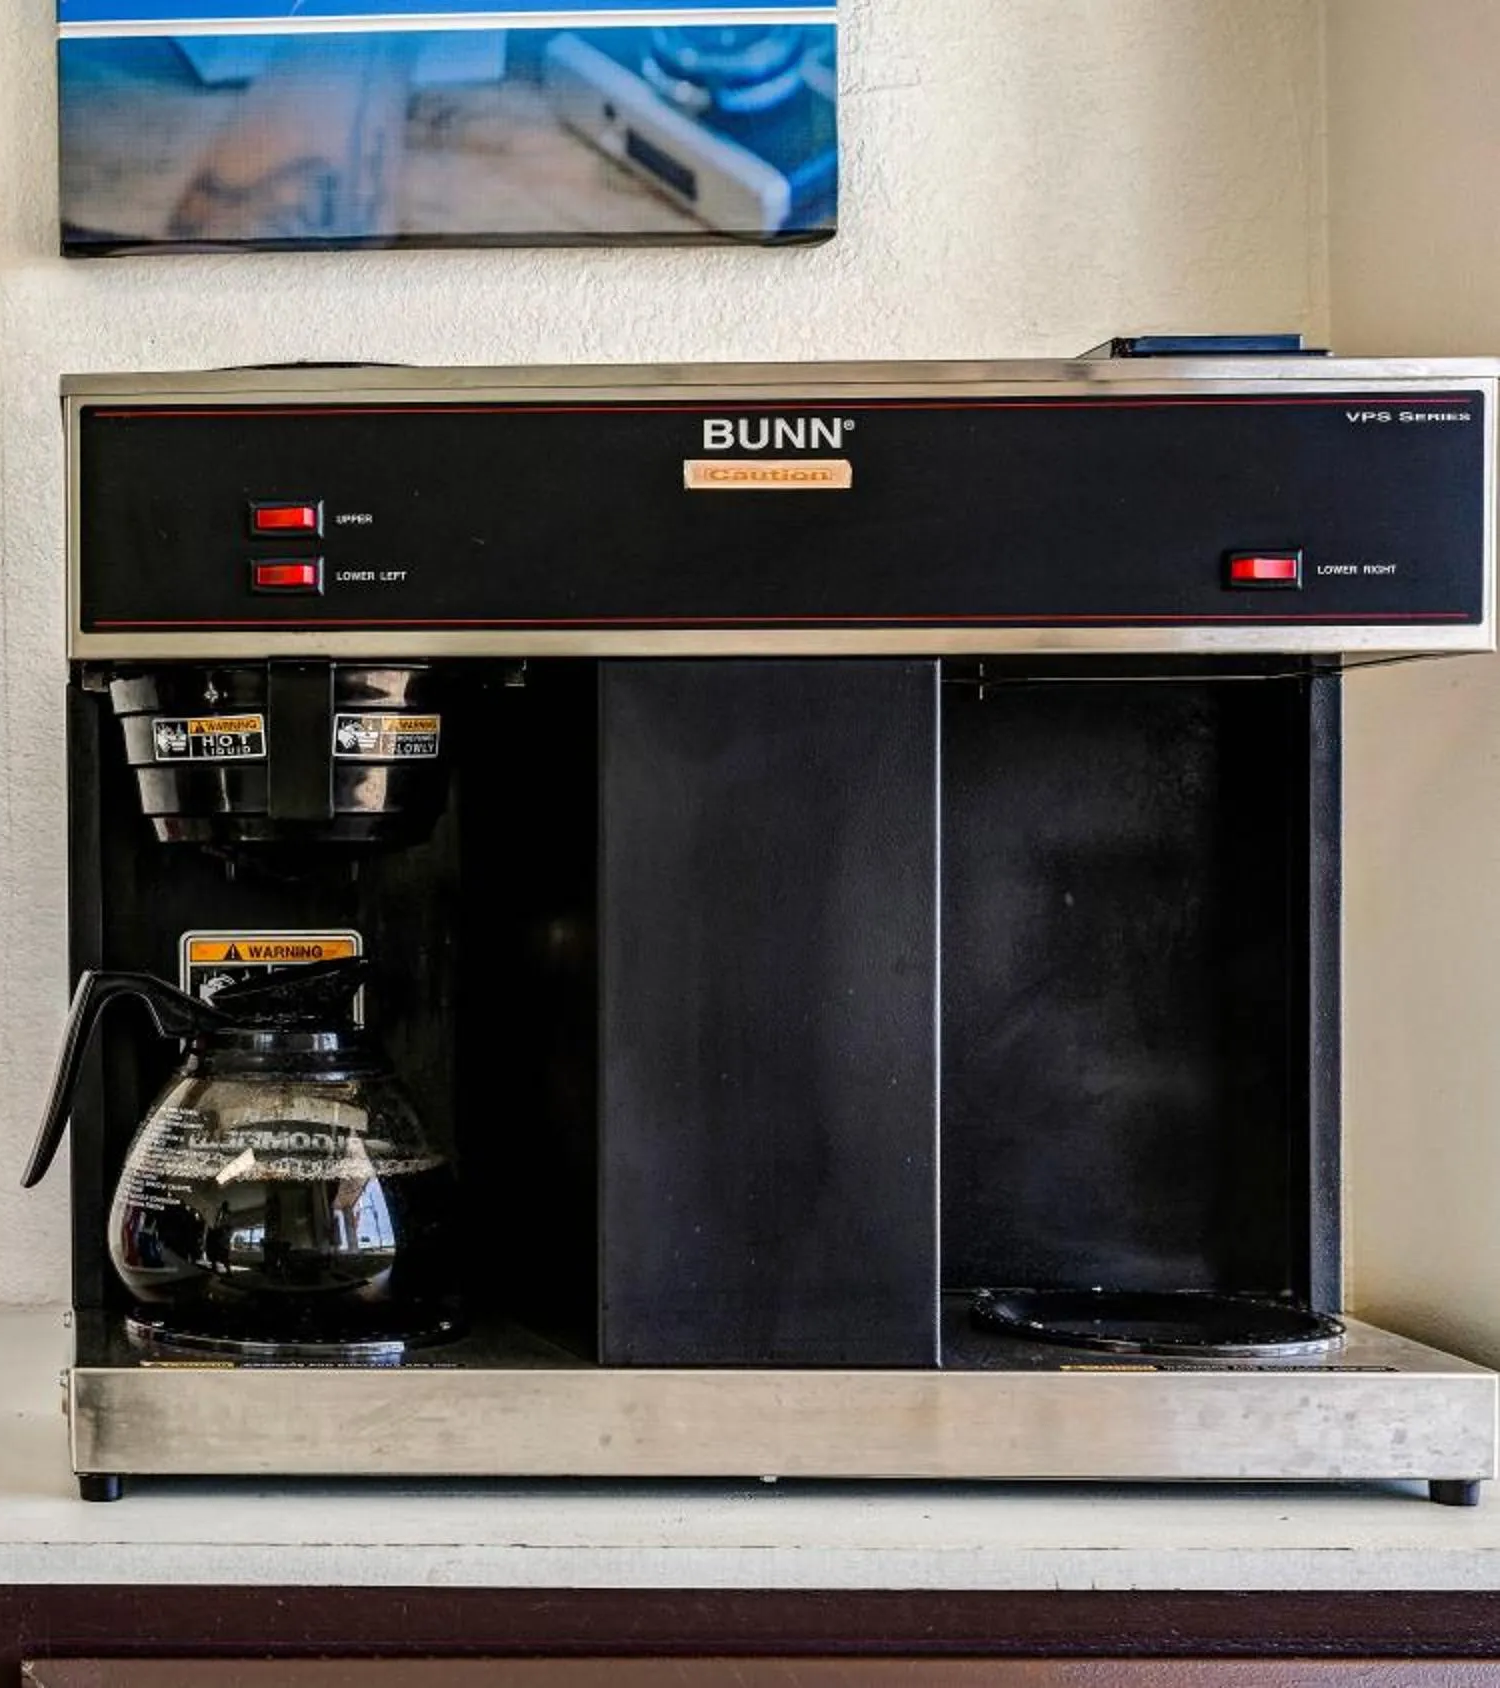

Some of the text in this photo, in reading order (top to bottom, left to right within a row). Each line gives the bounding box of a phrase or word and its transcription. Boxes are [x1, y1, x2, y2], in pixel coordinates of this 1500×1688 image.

[1346, 411, 1392, 423] VPS
[708, 468, 830, 481] Caution
[335, 513, 373, 525] UPPER
[336, 570, 407, 581] LOWER LEFT
[1317, 564, 1397, 575] LOWER RIGHT
[202, 733, 251, 747] HOT
[248, 945, 323, 958] WARNING
